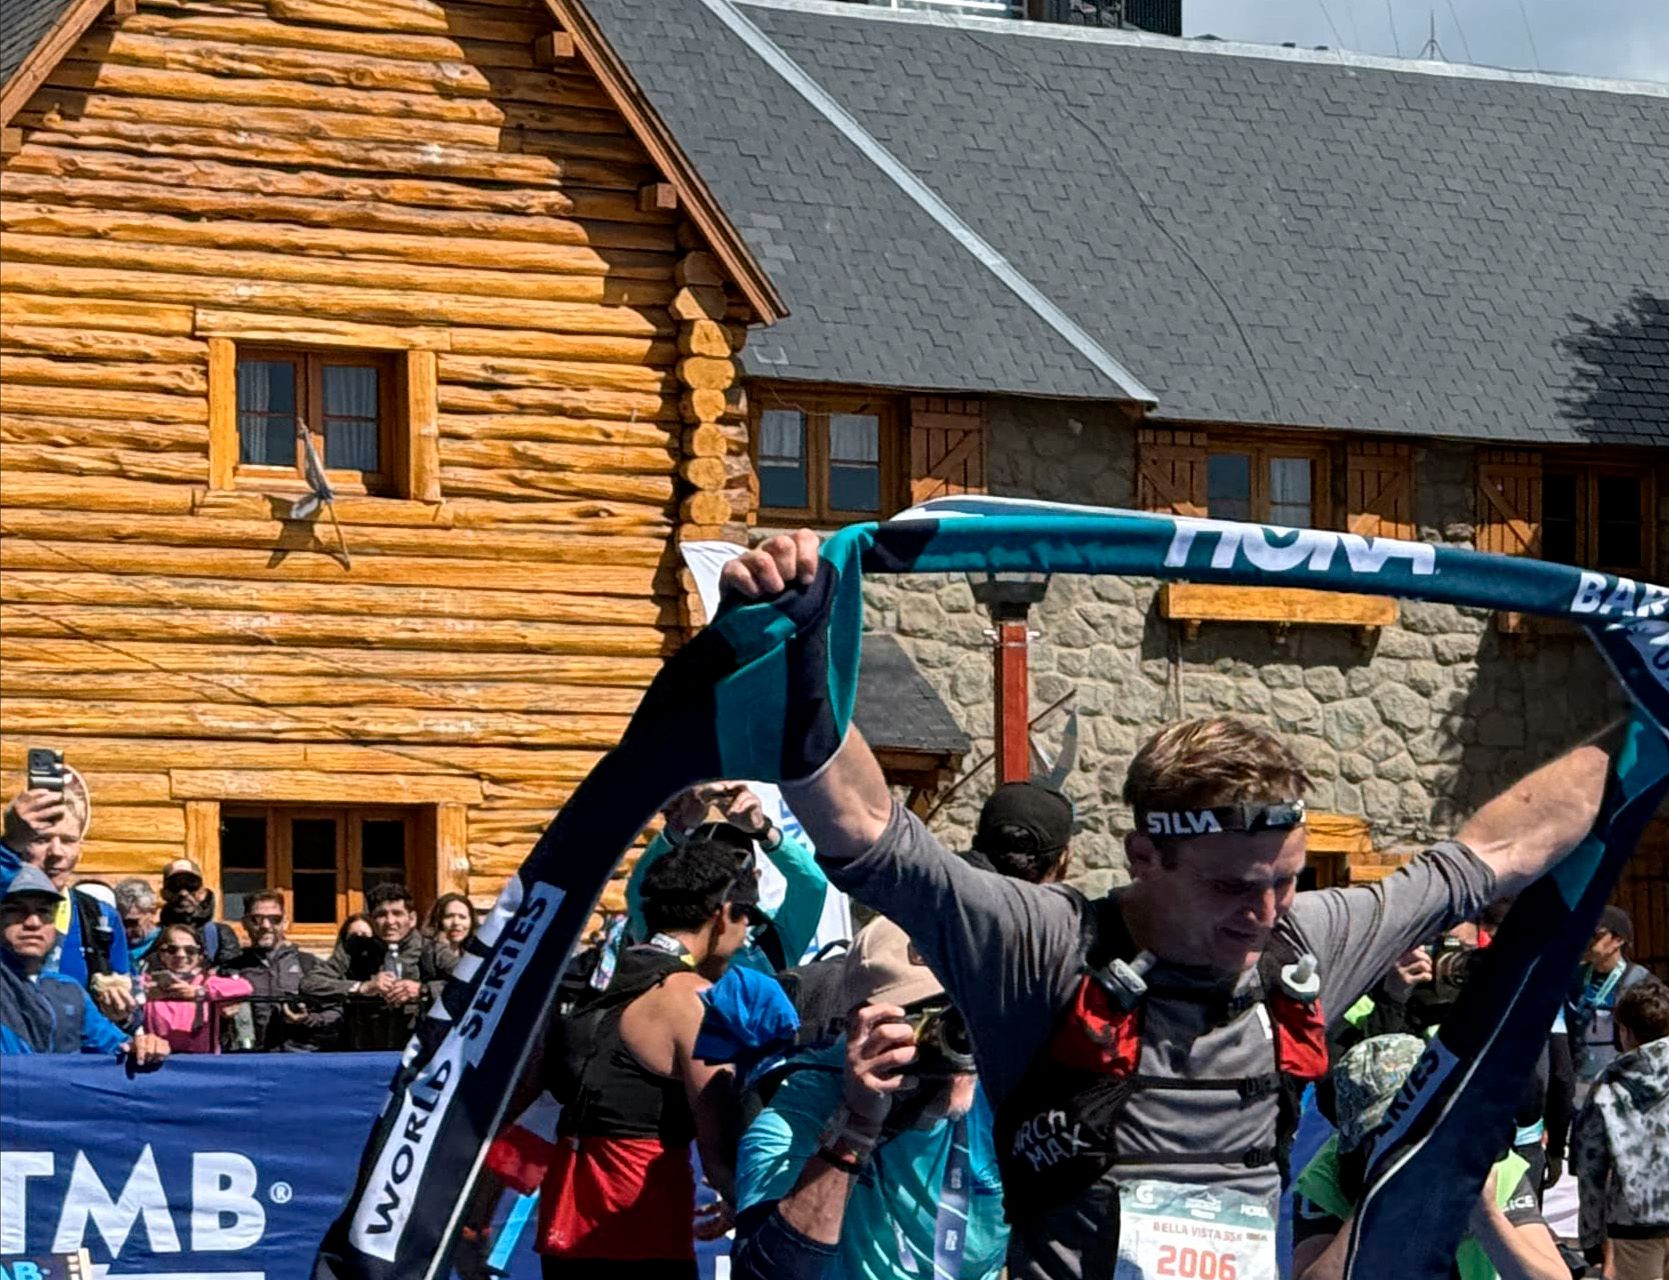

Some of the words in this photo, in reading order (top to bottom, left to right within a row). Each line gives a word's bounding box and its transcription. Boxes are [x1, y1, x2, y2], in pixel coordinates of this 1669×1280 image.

[1147, 810, 1223, 834] SILVA
[366, 1058, 452, 1235] WORLD
[459, 895, 548, 1040] SERIES
[1025, 1123, 1092, 1172] MAX
[1153, 1221, 1188, 1236] BELLA
[1191, 1226, 1222, 1241] VISTA
